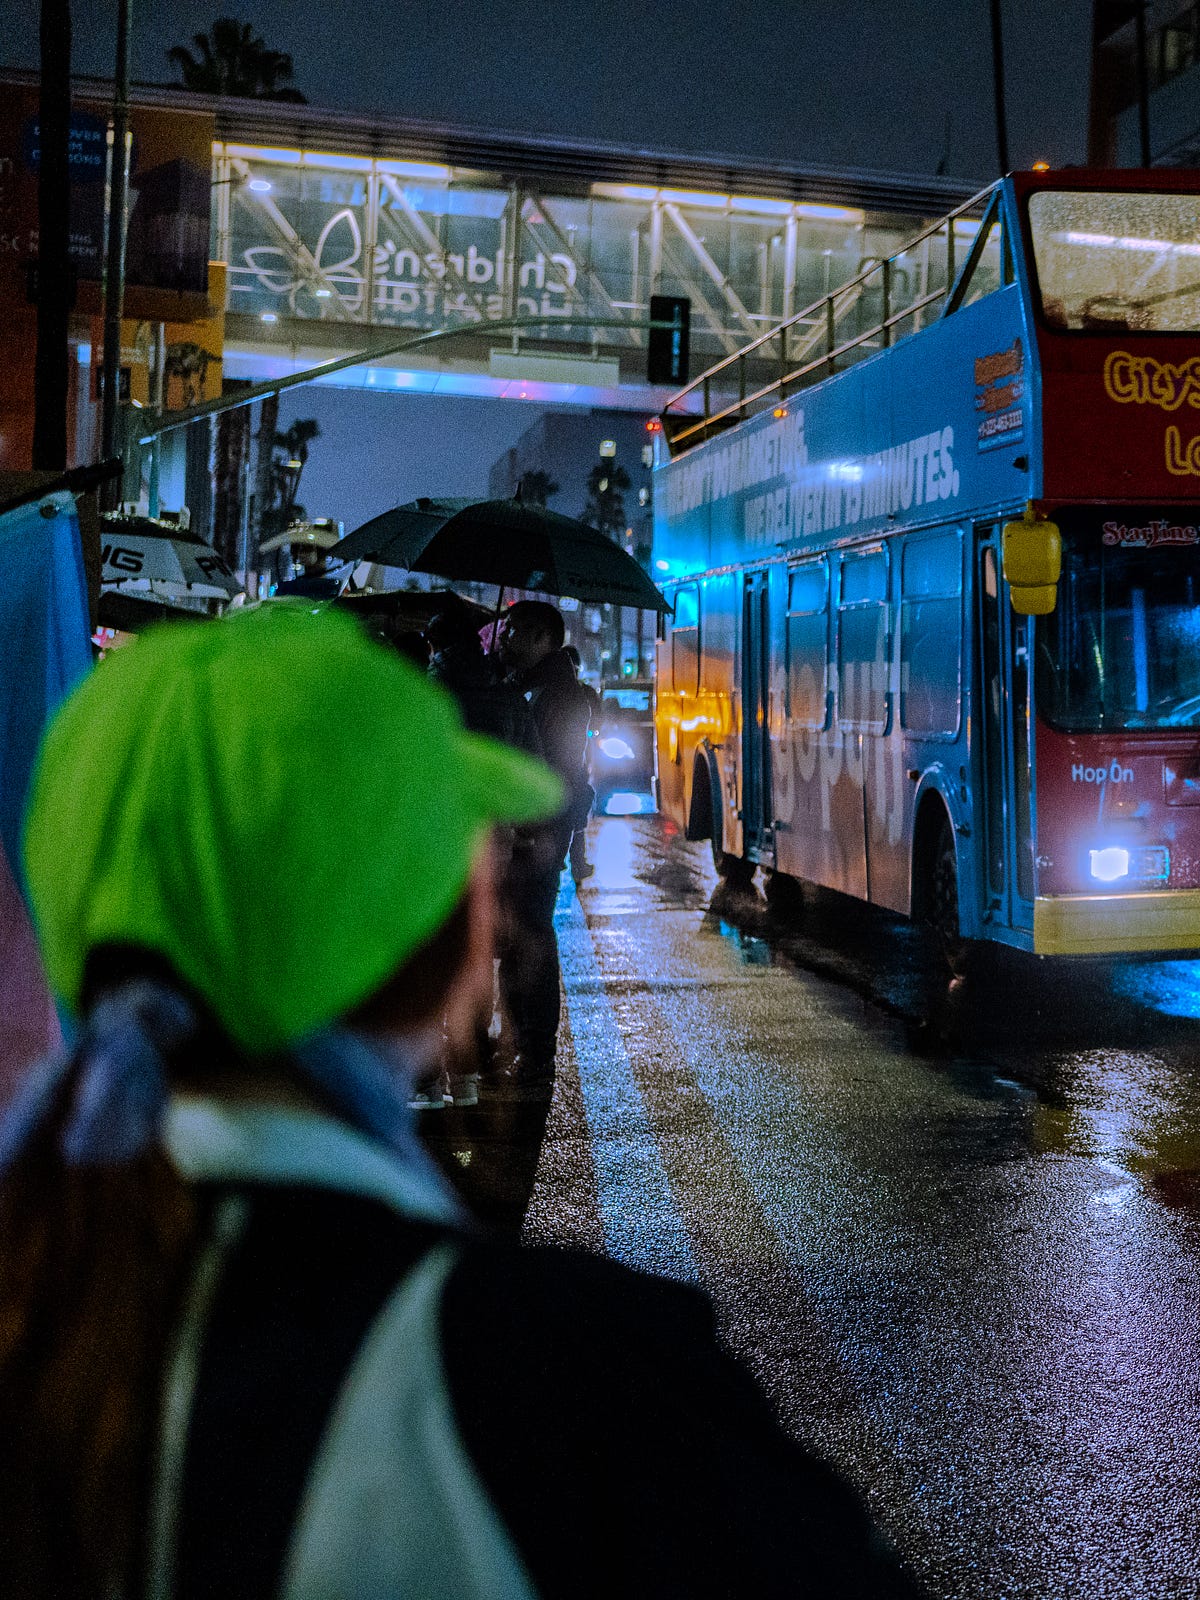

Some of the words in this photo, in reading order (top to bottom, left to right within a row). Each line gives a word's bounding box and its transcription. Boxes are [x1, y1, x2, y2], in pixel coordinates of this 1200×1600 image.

[745, 493, 766, 548] WE
[766, 474, 824, 543] DELIVER
[824, 464, 842, 529] IN
[863, 425, 960, 520] MINUTES.
[1071, 763, 1107, 785] Hop
[1109, 762, 1135, 783] On
